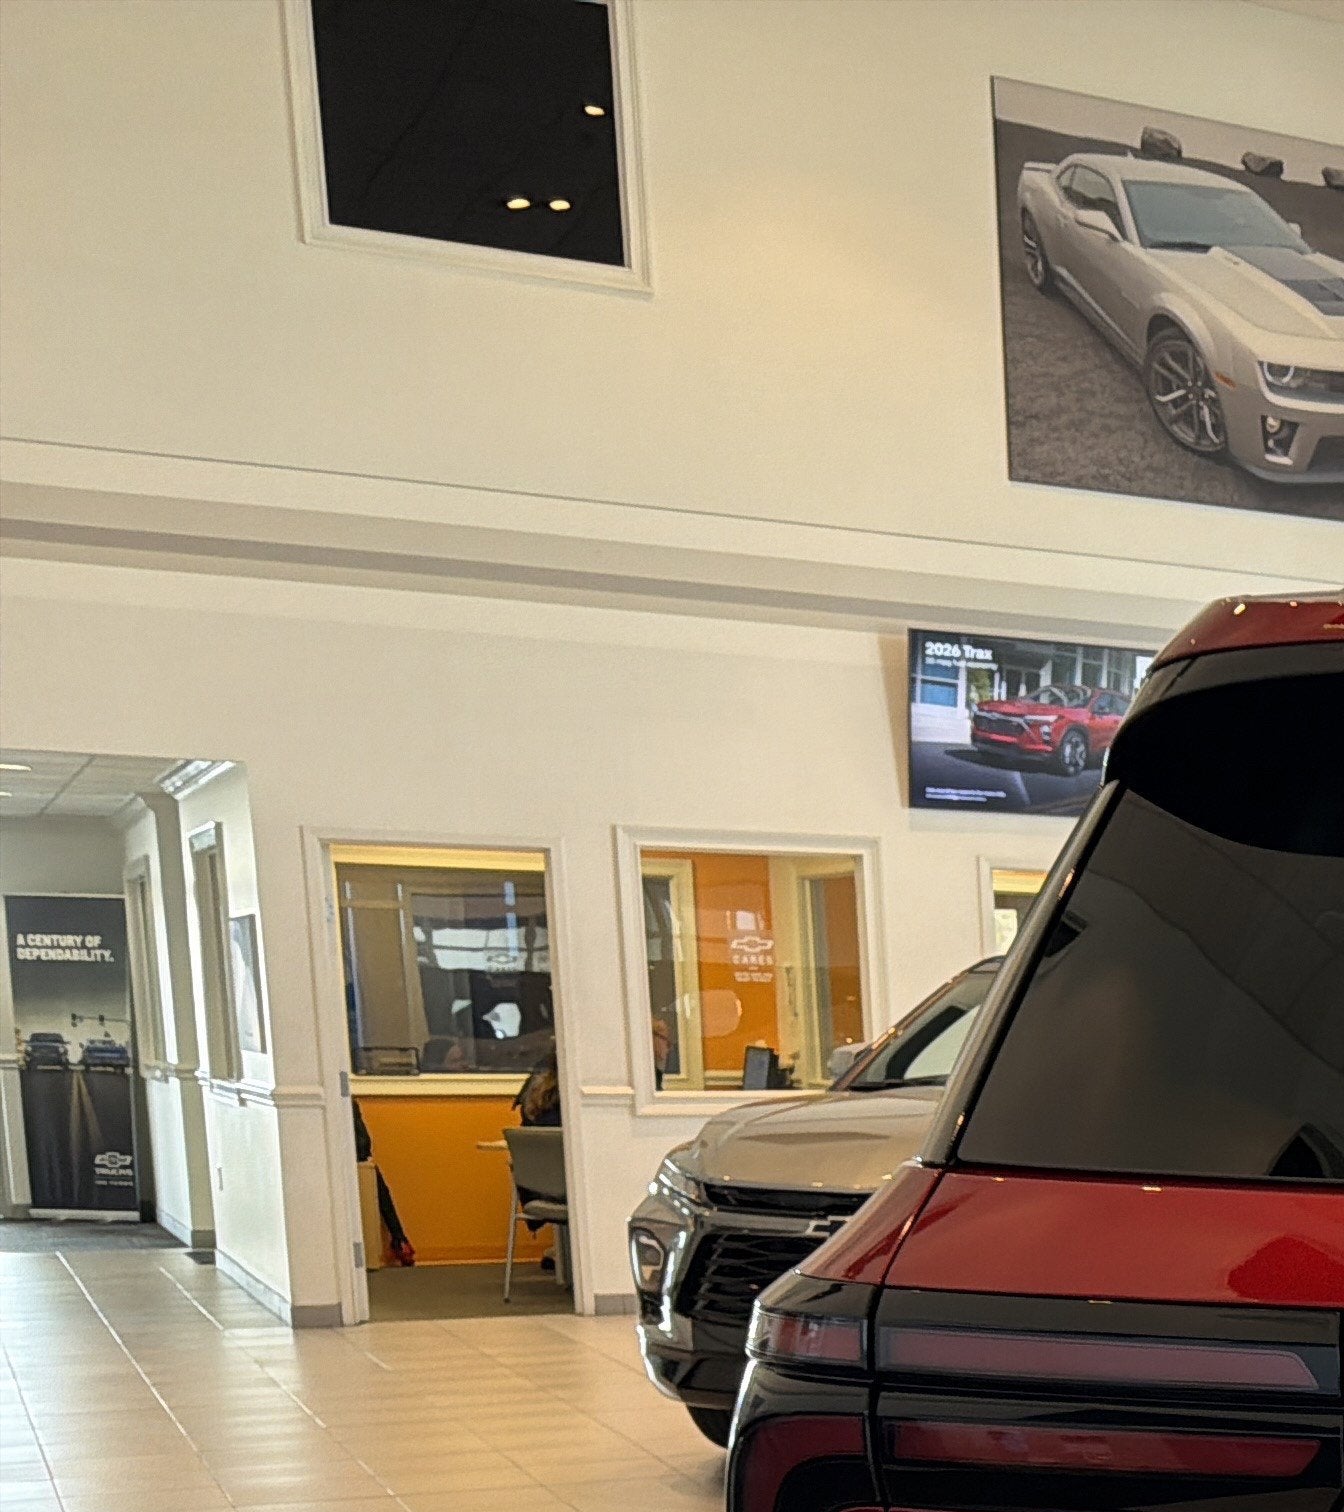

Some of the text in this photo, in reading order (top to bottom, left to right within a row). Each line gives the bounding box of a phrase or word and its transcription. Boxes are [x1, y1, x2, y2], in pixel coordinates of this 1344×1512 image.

[925, 641, 993, 660] 2026 Trax
[16, 933, 102, 947] A CENTURY OF
